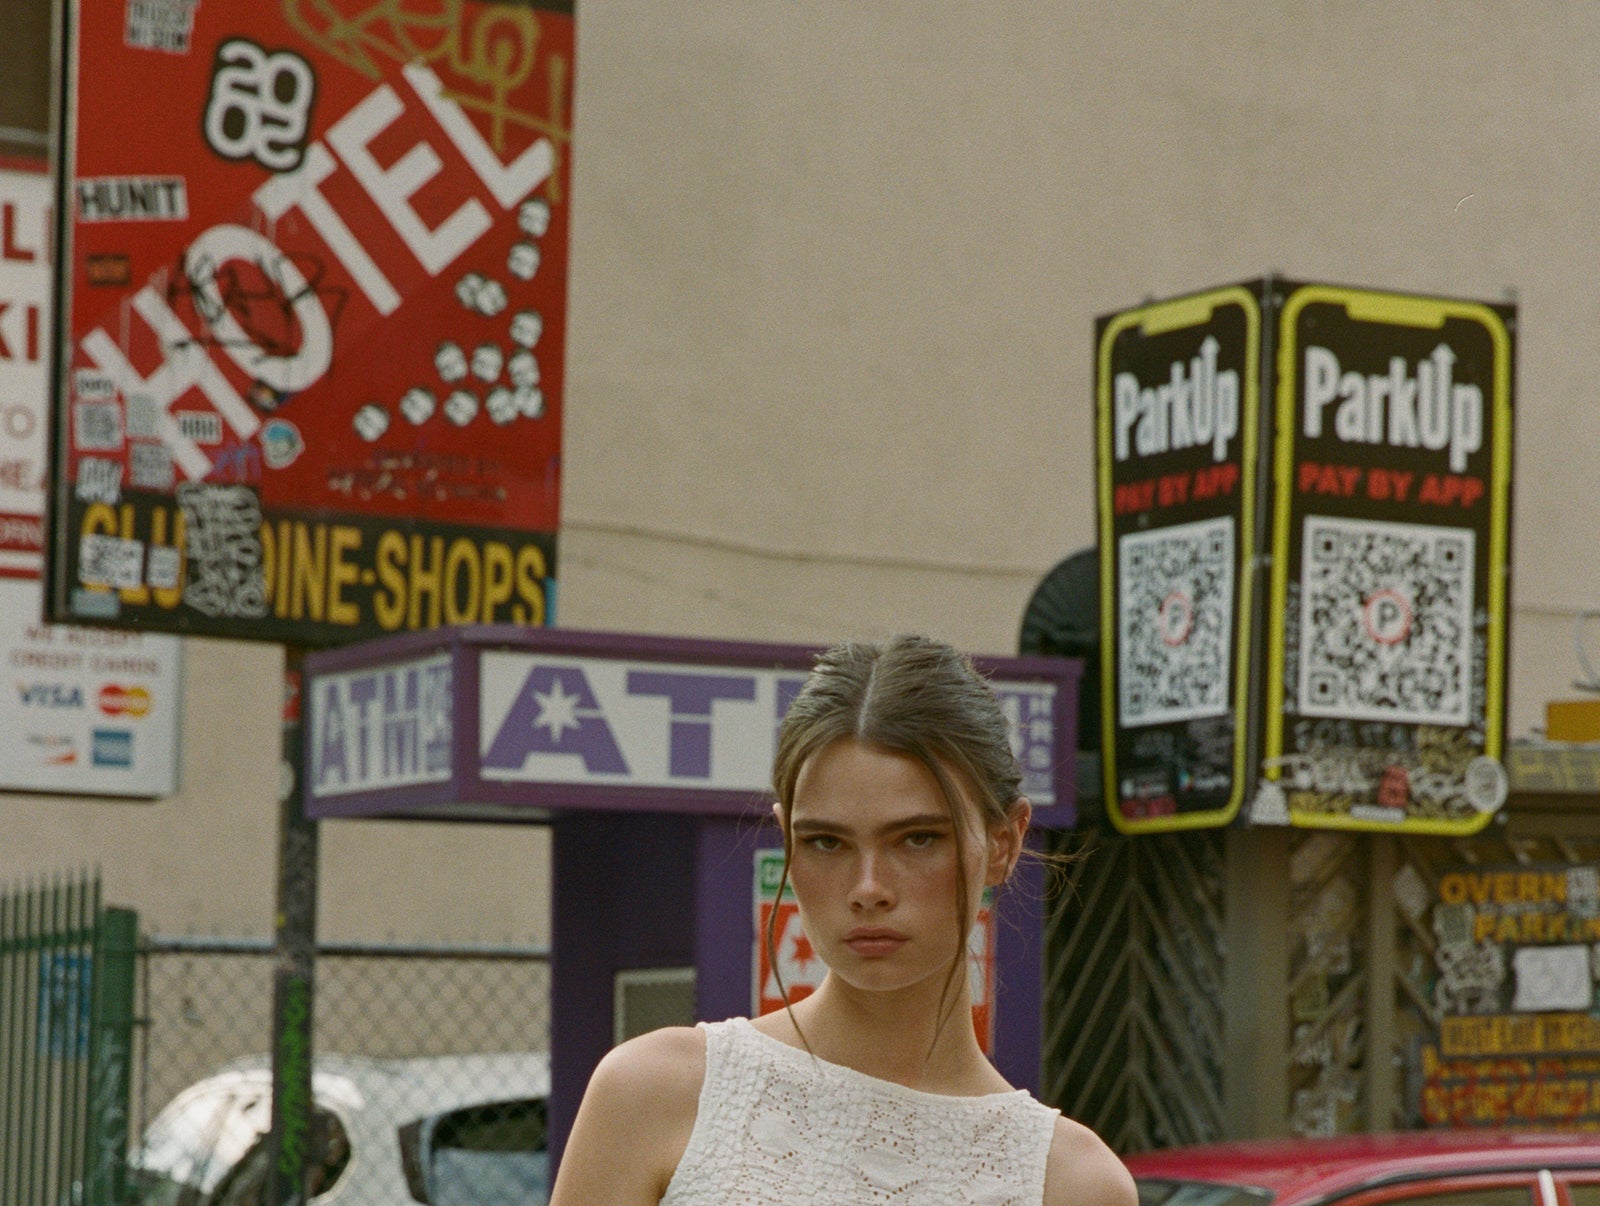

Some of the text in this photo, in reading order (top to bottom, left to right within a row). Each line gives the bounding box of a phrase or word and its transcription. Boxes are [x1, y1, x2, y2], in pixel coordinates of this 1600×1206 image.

[3, 202, 53, 264] L
[82, 62, 555, 481] HOTEL
[1113, 335, 1240, 462] ParkUp
[1302, 343, 1484, 474] ParkUp
[1159, 474, 1191, 507] BY
[1299, 461, 1485, 508] PAY BY APP
[1377, 602, 1400, 628] P
[17, 681, 83, 709] VISA
[482, 664, 812, 781] AT
[317, 667, 420, 786] ATM
[1440, 873, 1575, 904] OVERN
